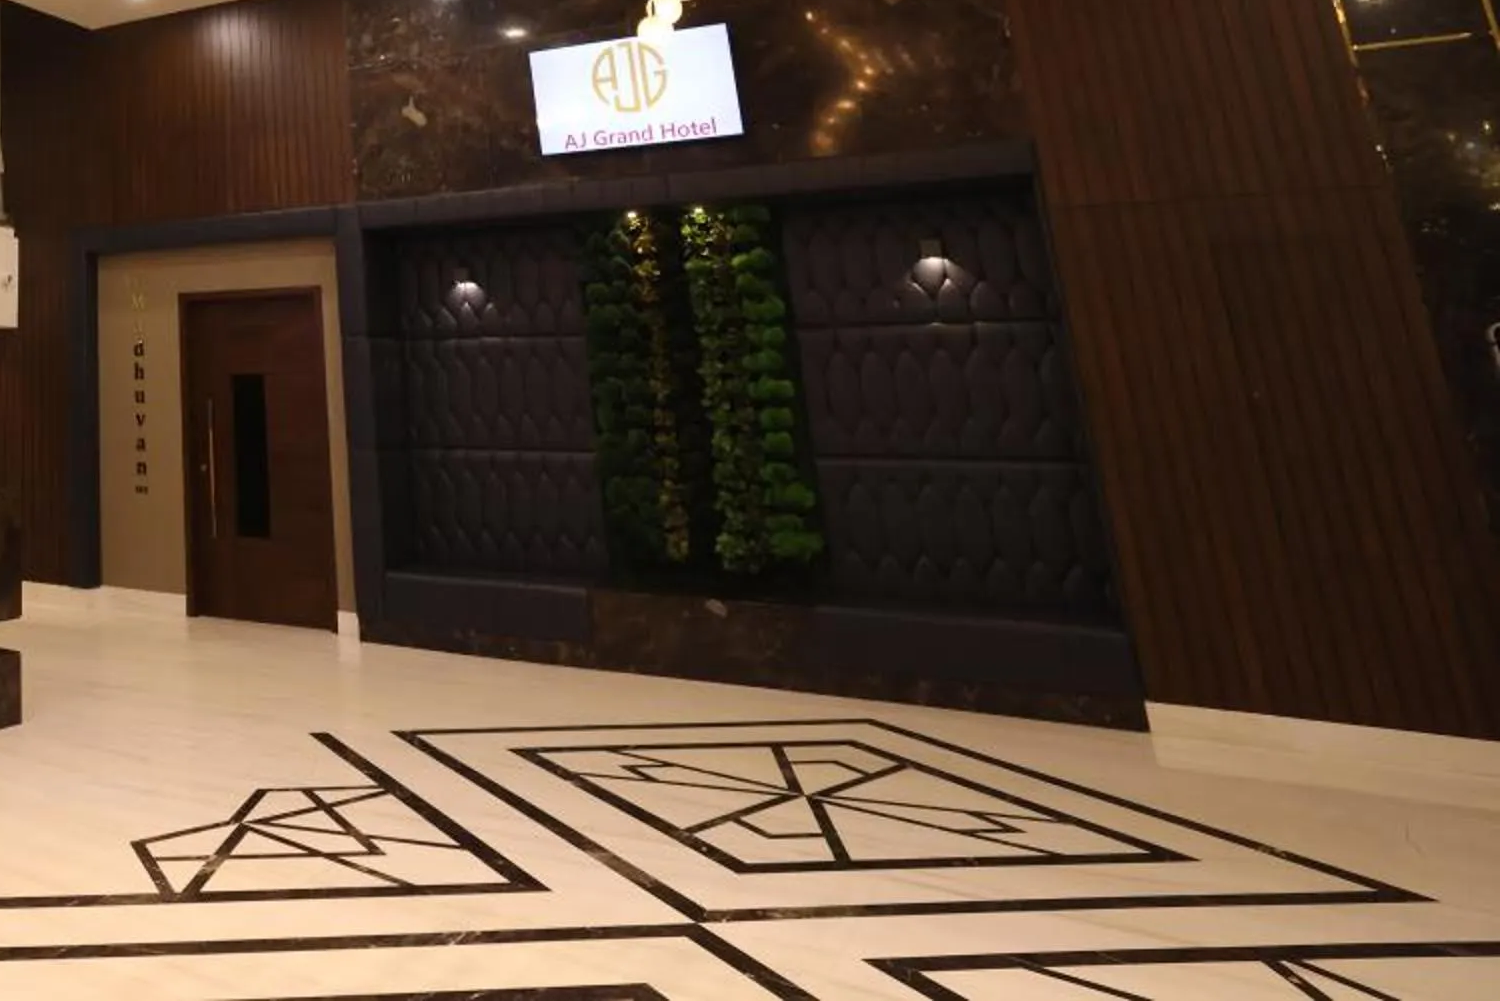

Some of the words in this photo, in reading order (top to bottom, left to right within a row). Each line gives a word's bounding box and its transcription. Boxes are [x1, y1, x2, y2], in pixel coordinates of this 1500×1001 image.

[592, 41, 668, 112] AJG
[565, 132, 587, 150] AJ
[593, 124, 654, 146] Grand
[660, 116, 718, 139] Hotel
[132, 294, 148, 476] Mdhuvan
